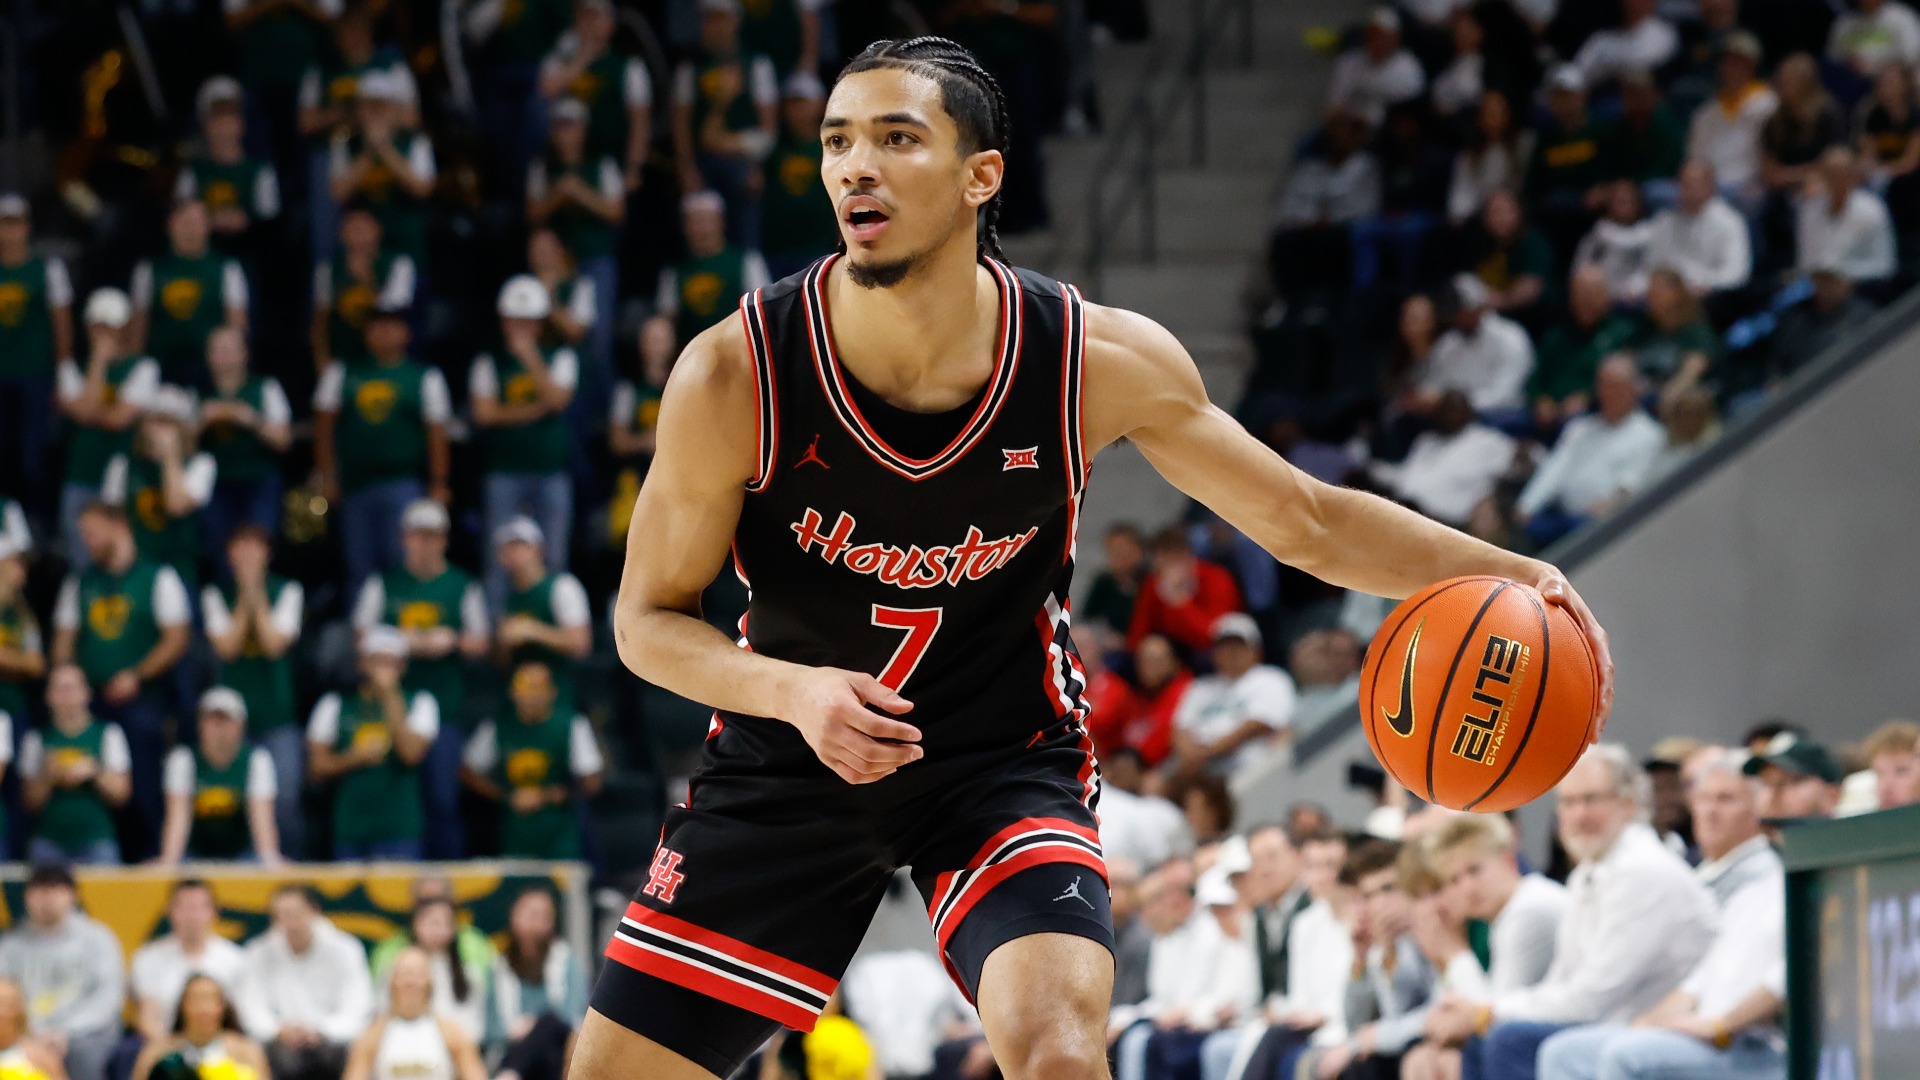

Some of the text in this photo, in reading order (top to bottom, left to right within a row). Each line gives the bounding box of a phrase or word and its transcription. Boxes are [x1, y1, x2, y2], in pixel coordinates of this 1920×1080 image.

[790, 507, 1039, 589] Houston
[871, 603, 943, 693] 7
[1450, 633, 1522, 763] ELITE
[1485, 645, 1531, 766] CHAMPIONSHIP
